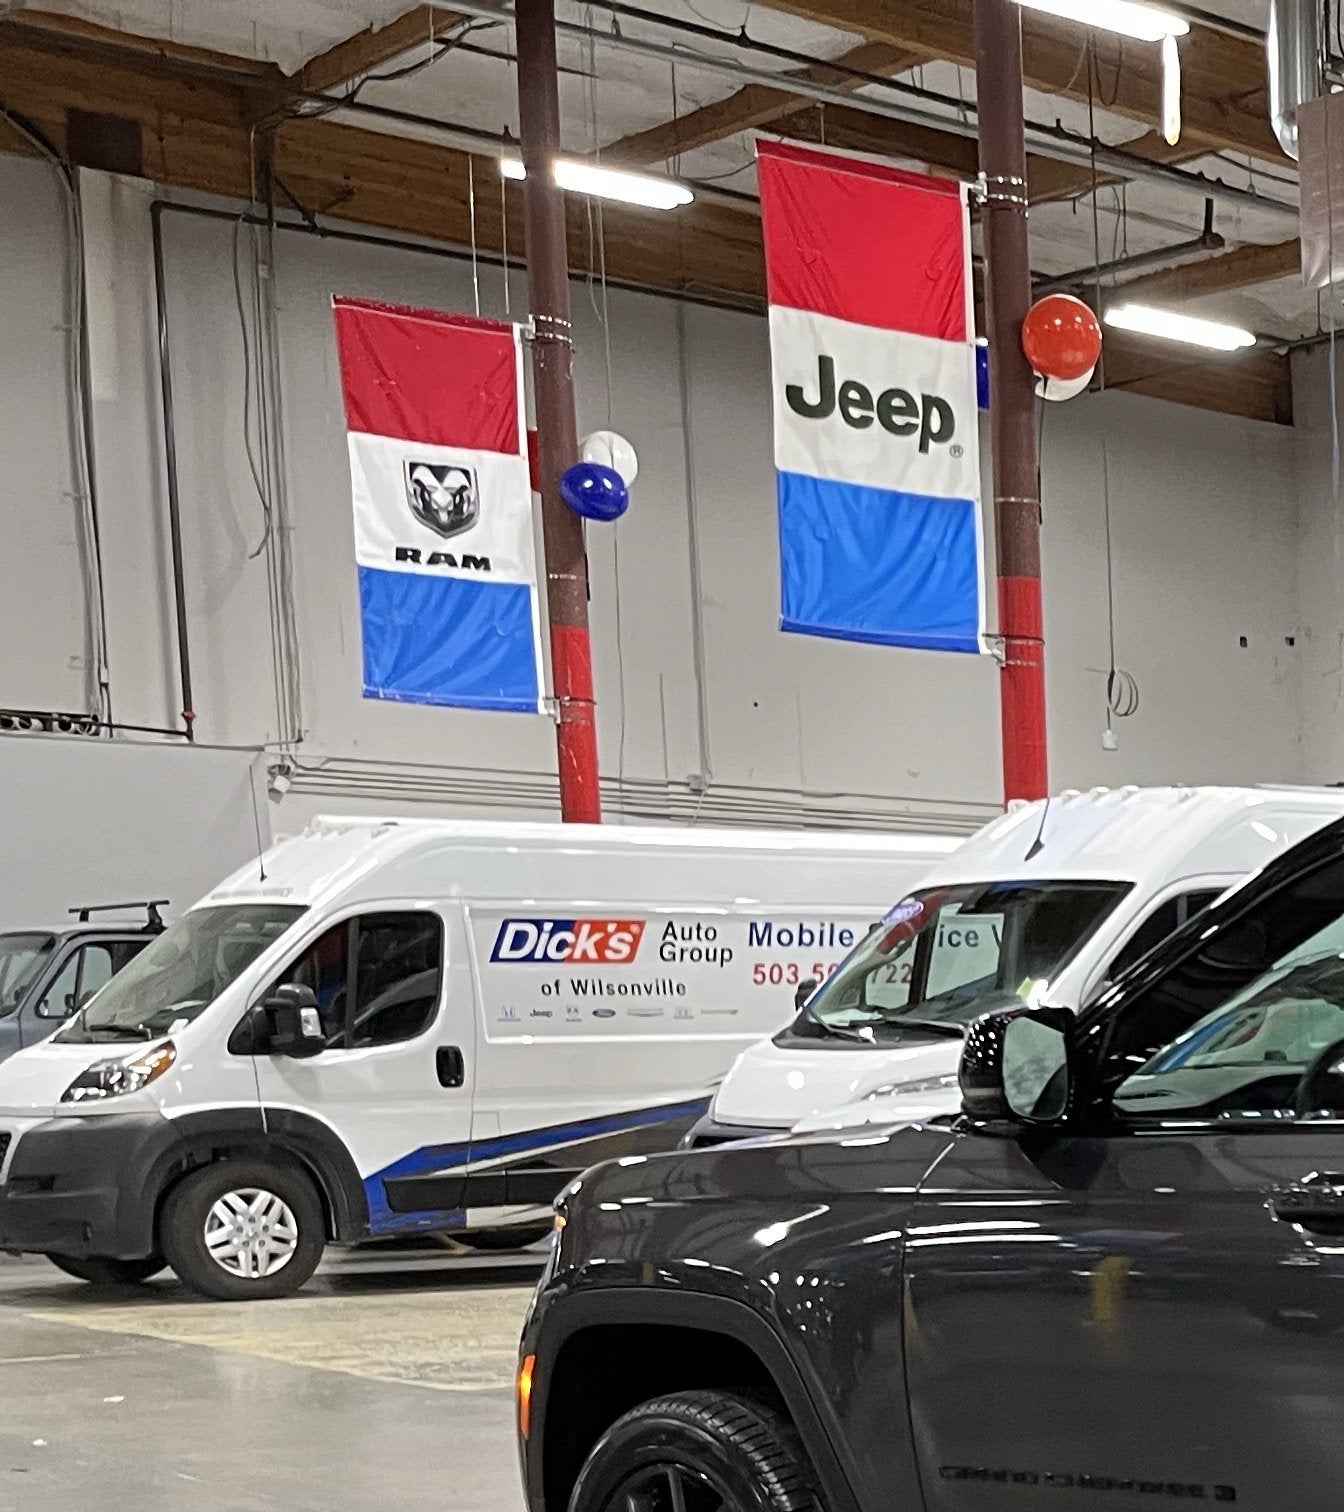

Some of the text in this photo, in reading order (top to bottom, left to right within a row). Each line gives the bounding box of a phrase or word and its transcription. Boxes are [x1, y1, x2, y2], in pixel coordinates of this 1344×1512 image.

[785, 354, 956, 454] Jeep
[395, 546, 492, 572] RAM
[498, 921, 635, 961] Dick's
[662, 920, 718, 942] Auto
[749, 922, 854, 948] Mobile
[659, 942, 734, 968] Group
[753, 962, 799, 985] 503
[541, 978, 687, 997] of Wilsonville
